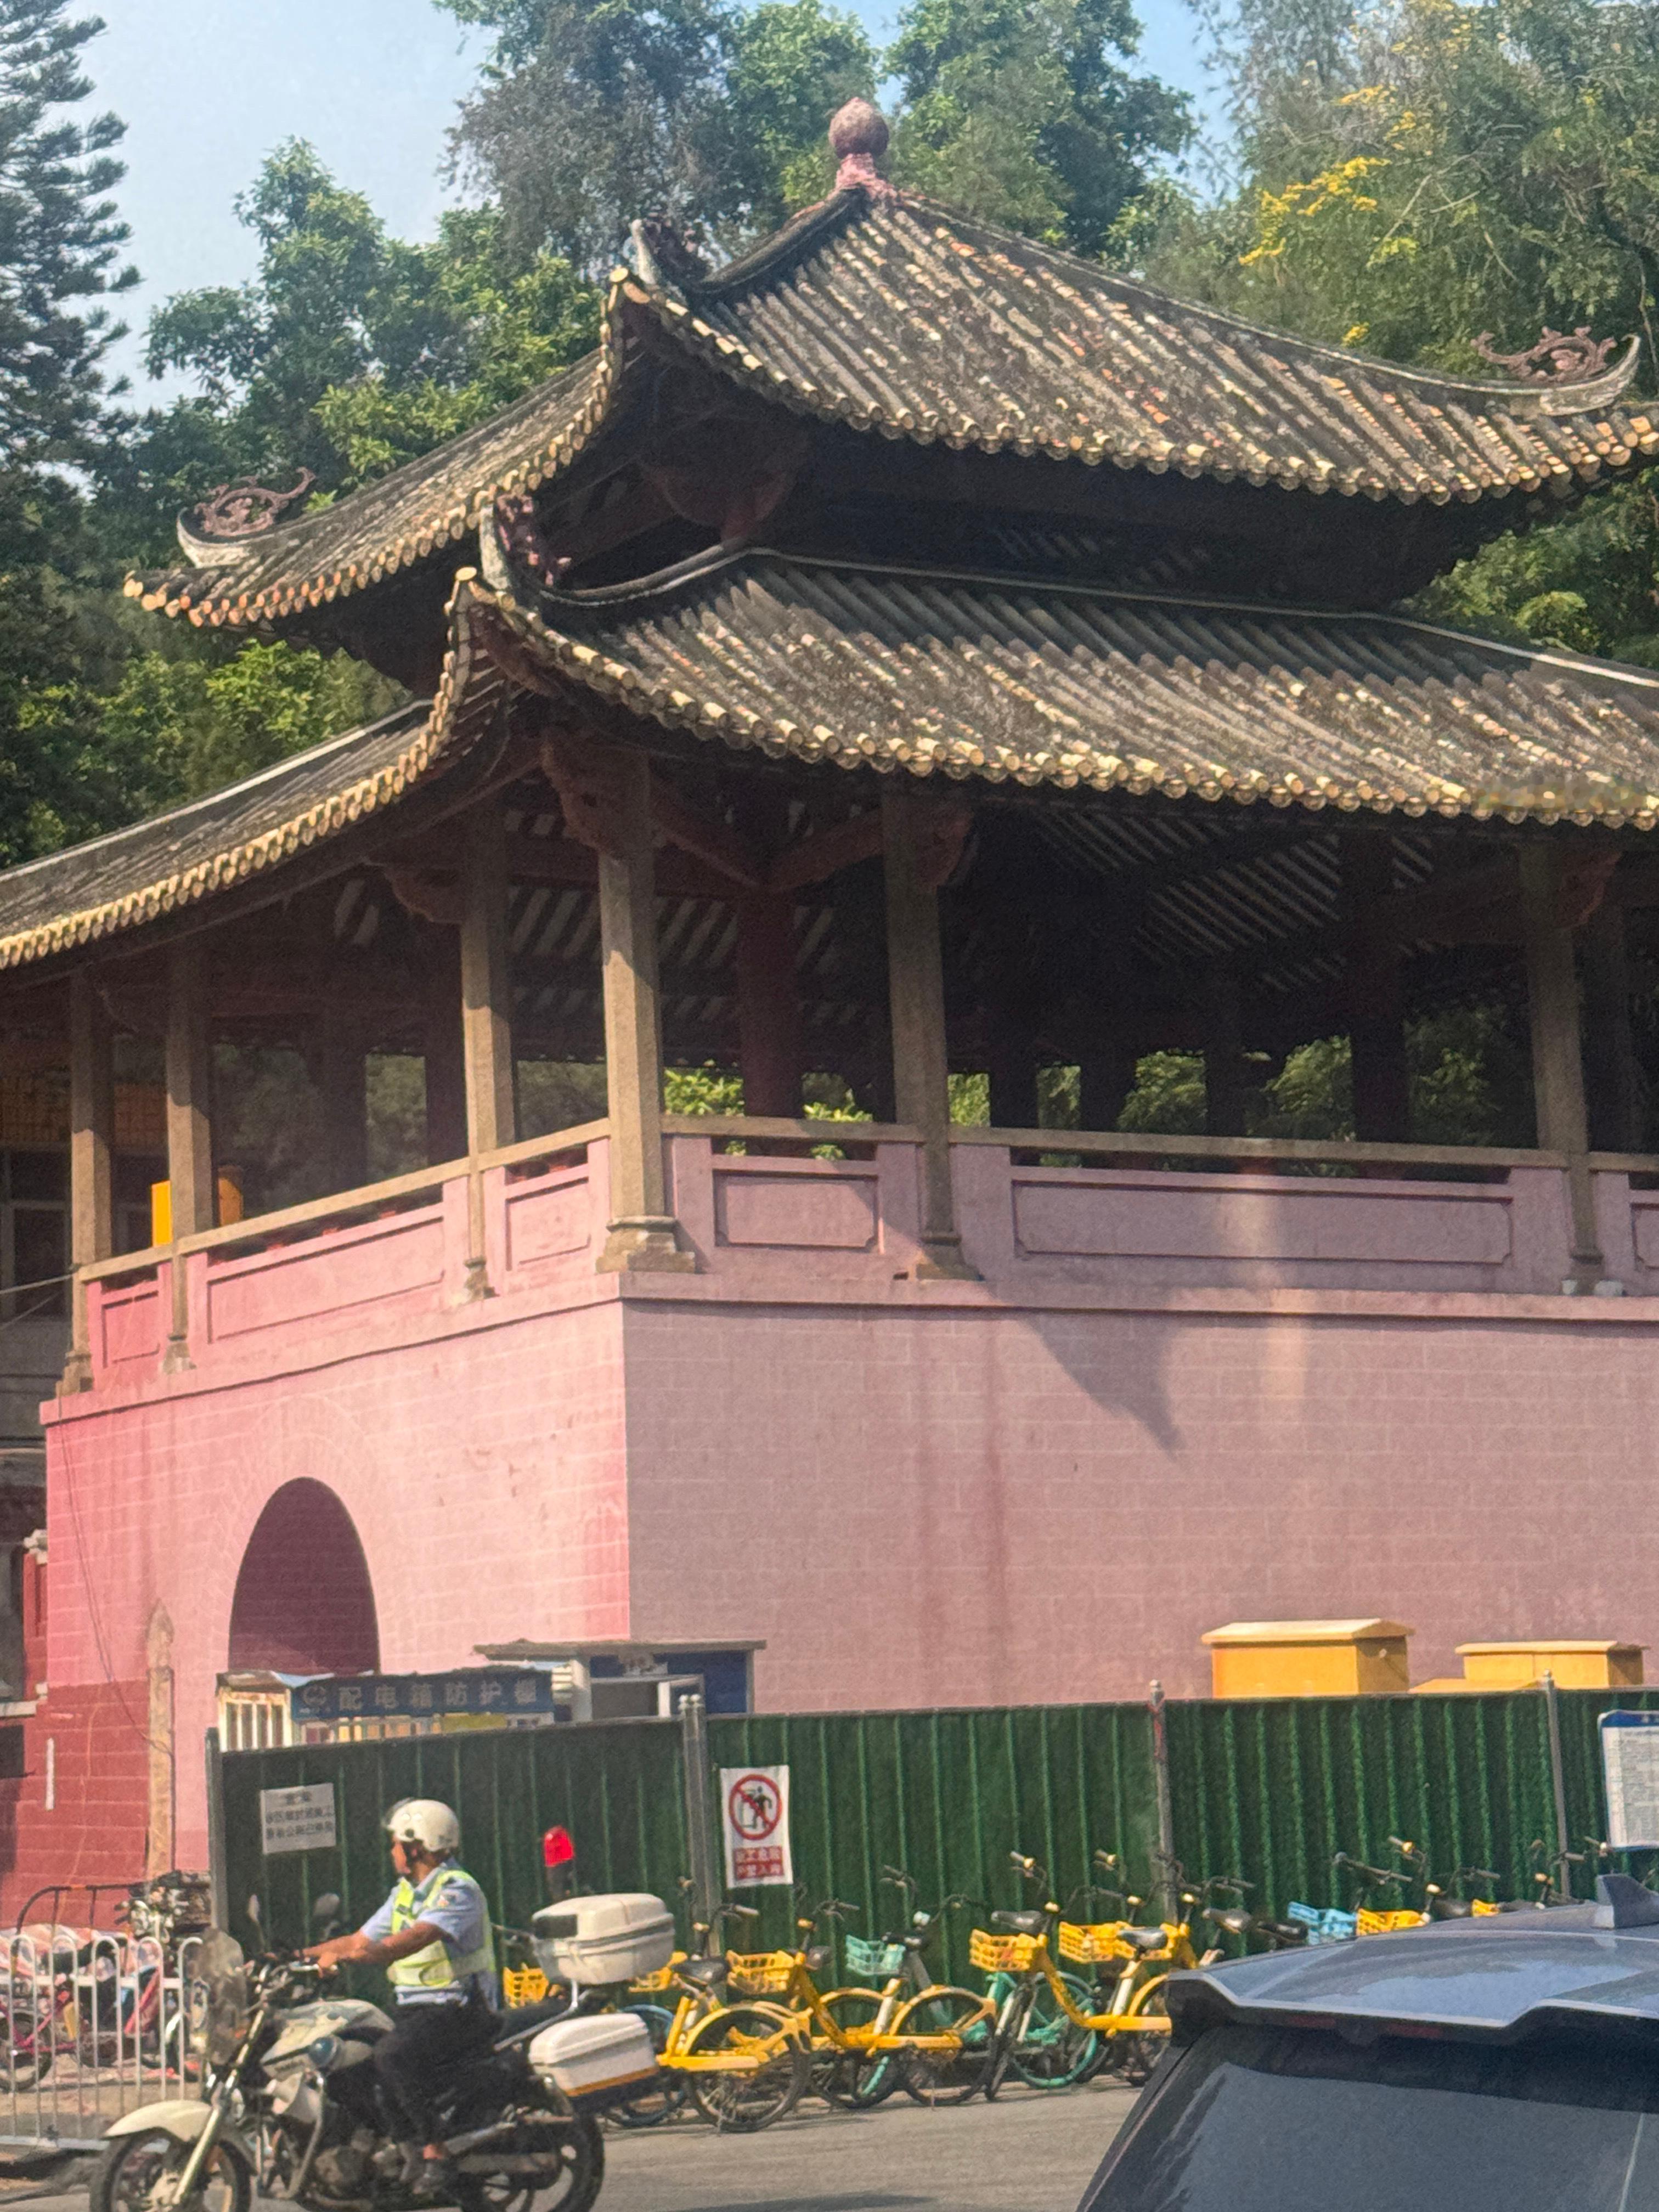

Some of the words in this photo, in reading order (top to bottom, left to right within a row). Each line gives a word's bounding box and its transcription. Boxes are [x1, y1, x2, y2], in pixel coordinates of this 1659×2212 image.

[340, 1679, 537, 1710] 配电箱防护棚
